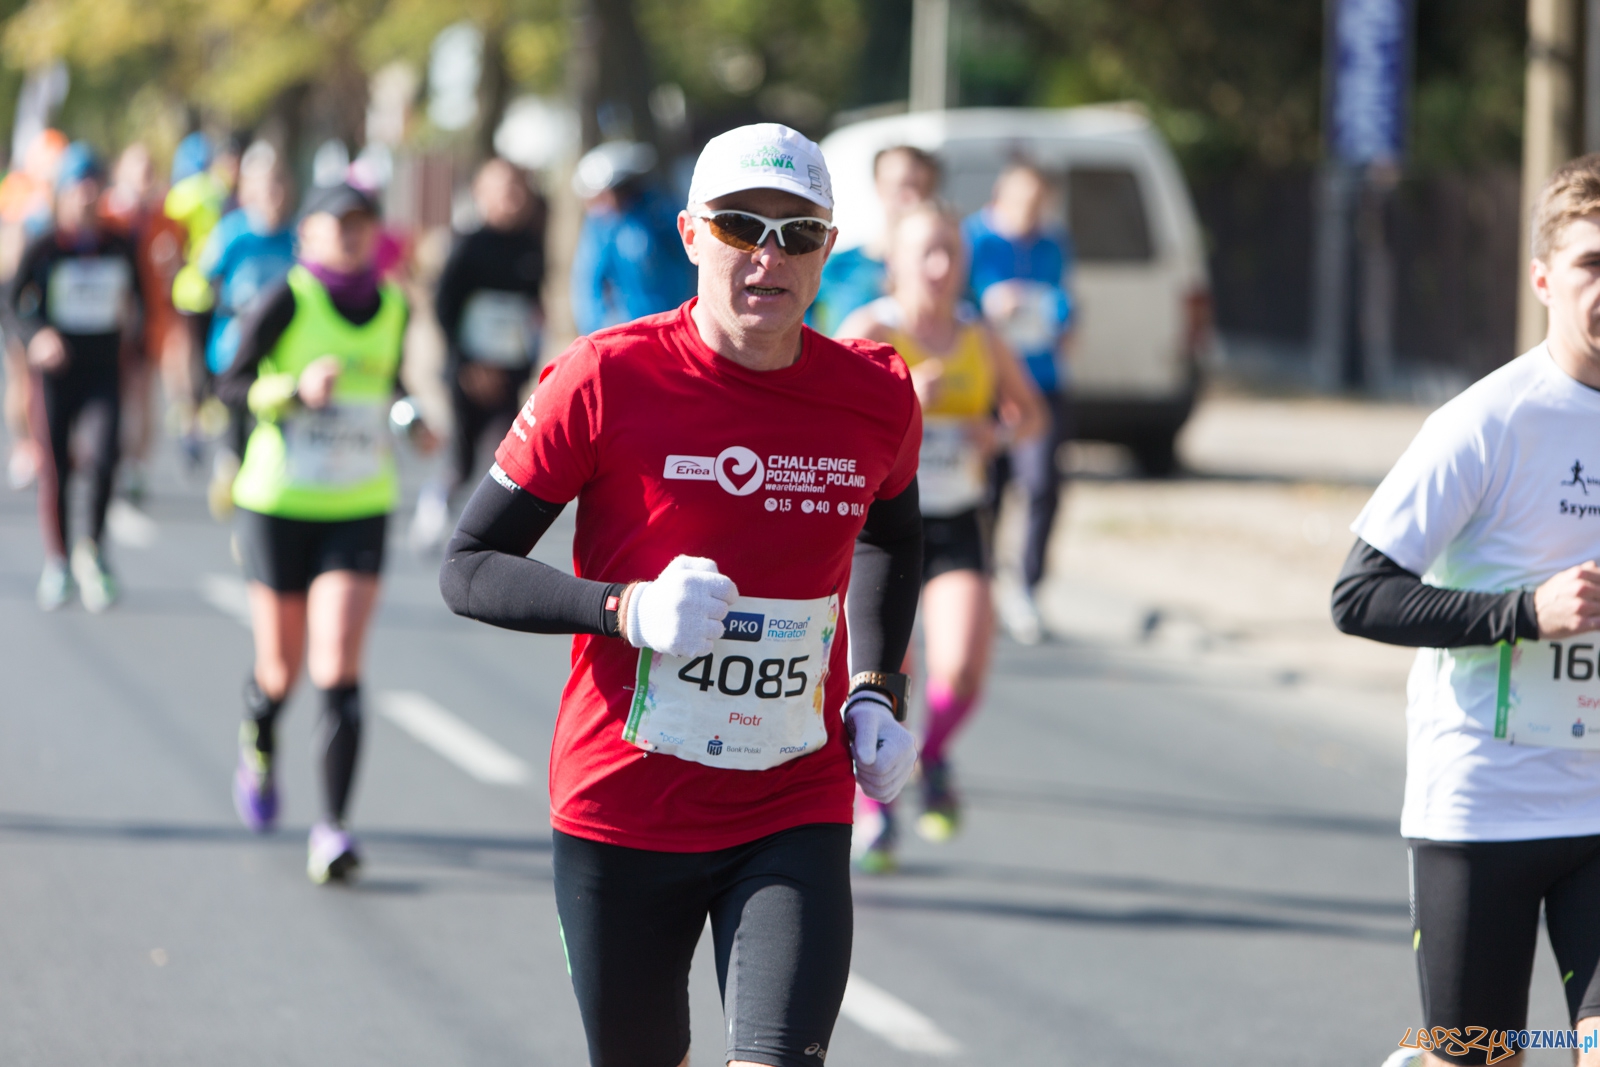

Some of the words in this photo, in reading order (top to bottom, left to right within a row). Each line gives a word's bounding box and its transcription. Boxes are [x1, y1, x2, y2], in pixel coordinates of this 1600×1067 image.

[676, 465, 710, 476] Enea
[767, 455, 857, 472] CHALLENGE
[765, 469, 815, 484] POZNAŃ
[826, 473, 866, 488] POLAND
[765, 483, 826, 494] wearetriathlon!
[778, 499, 792, 512] 1,5
[816, 501, 830, 514] 40
[729, 620, 759, 634] PKO
[767, 629, 806, 638] maraton
[1549, 642, 1600, 681] 16
[678, 652, 809, 699] 4085
[728, 712, 762, 726] Piotr
